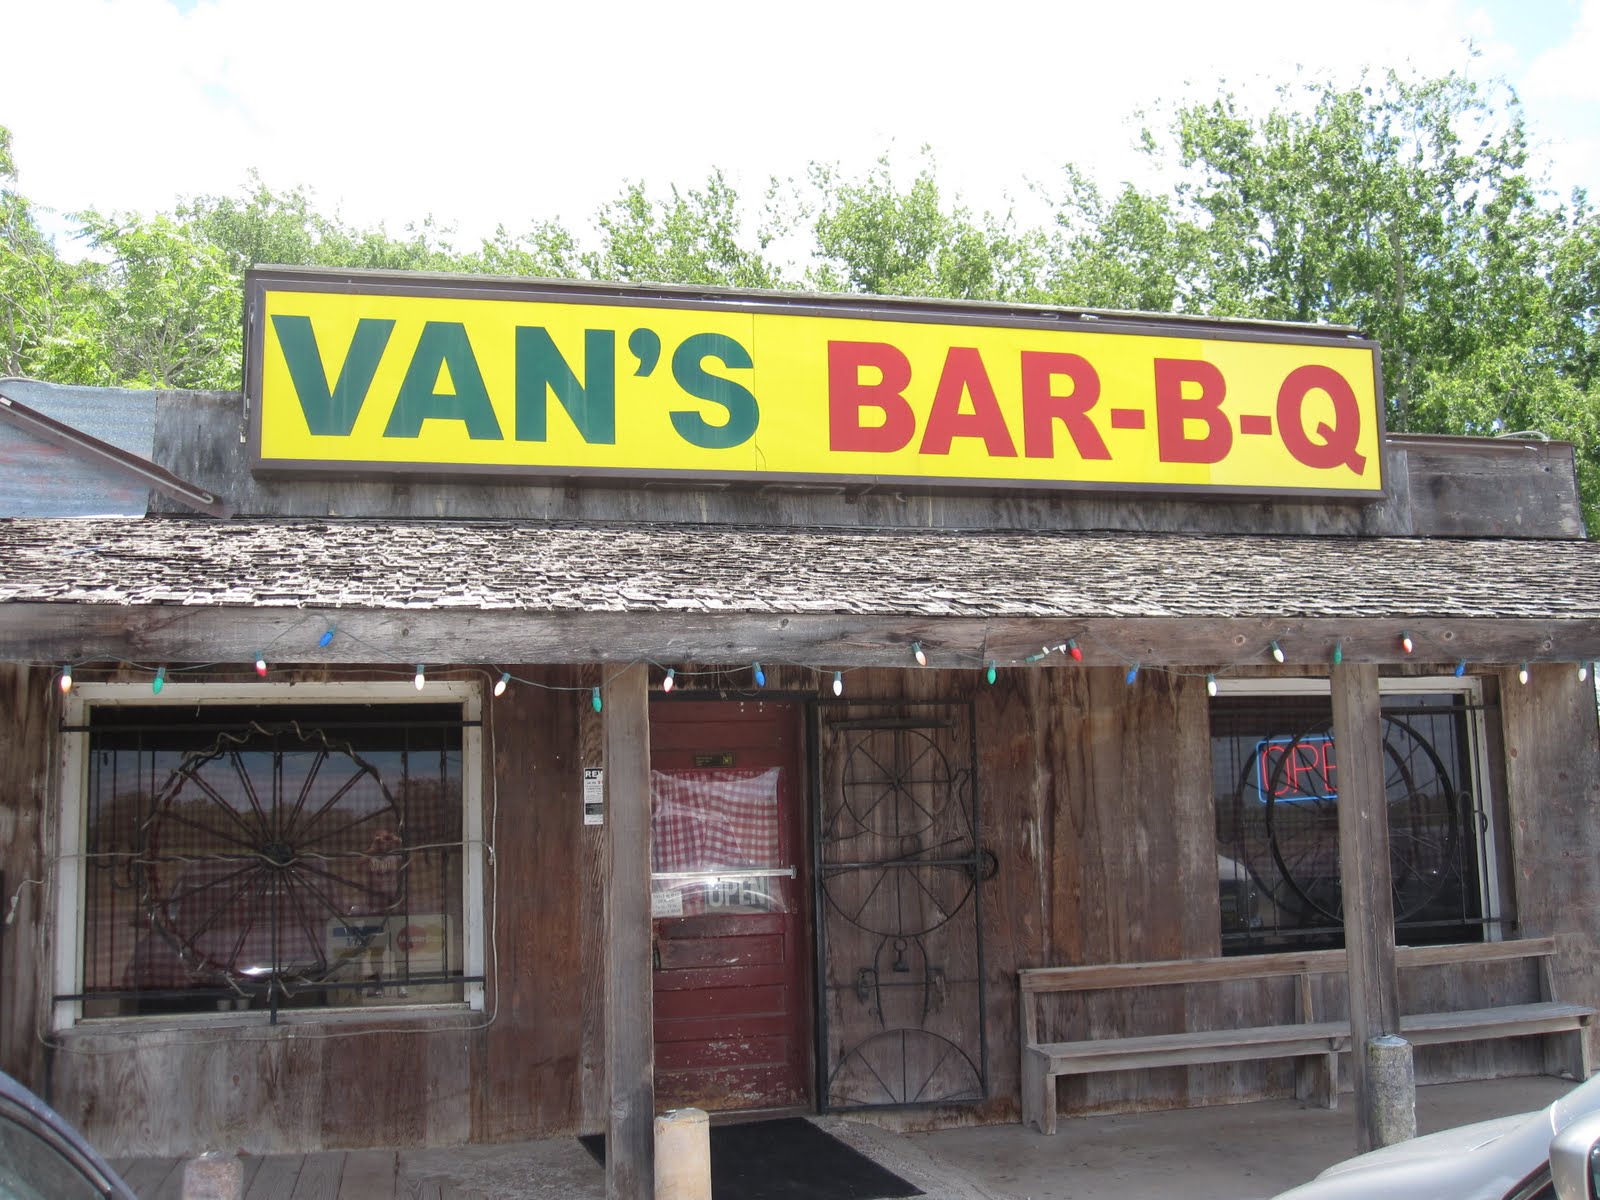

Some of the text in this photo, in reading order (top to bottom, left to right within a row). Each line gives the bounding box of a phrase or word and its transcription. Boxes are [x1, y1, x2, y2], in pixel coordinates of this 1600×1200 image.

[271, 314, 1367, 476] VAN'S BAR-B-Q
[707, 877, 767, 907] OPEN
